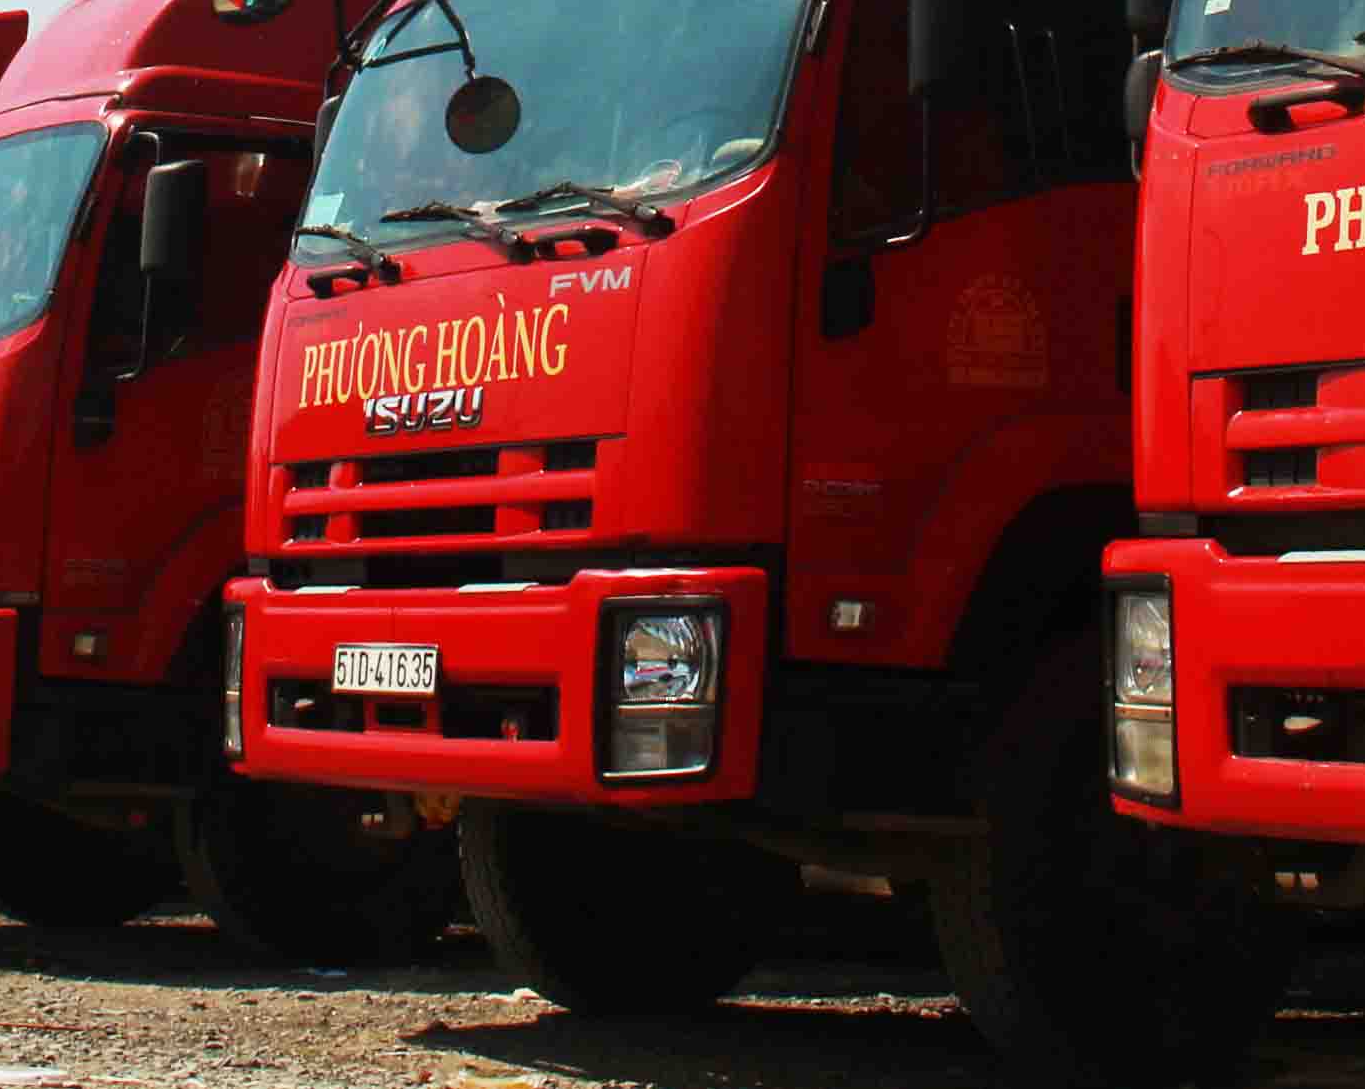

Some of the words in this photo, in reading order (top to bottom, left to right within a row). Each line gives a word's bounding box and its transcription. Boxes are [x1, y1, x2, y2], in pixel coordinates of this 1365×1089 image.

[550, 266, 631, 298] FVM
[433, 292, 569, 389] HOÀNG
[363, 387, 484, 436] ISUZU
[336, 651, 434, 688] 51D-416.35
